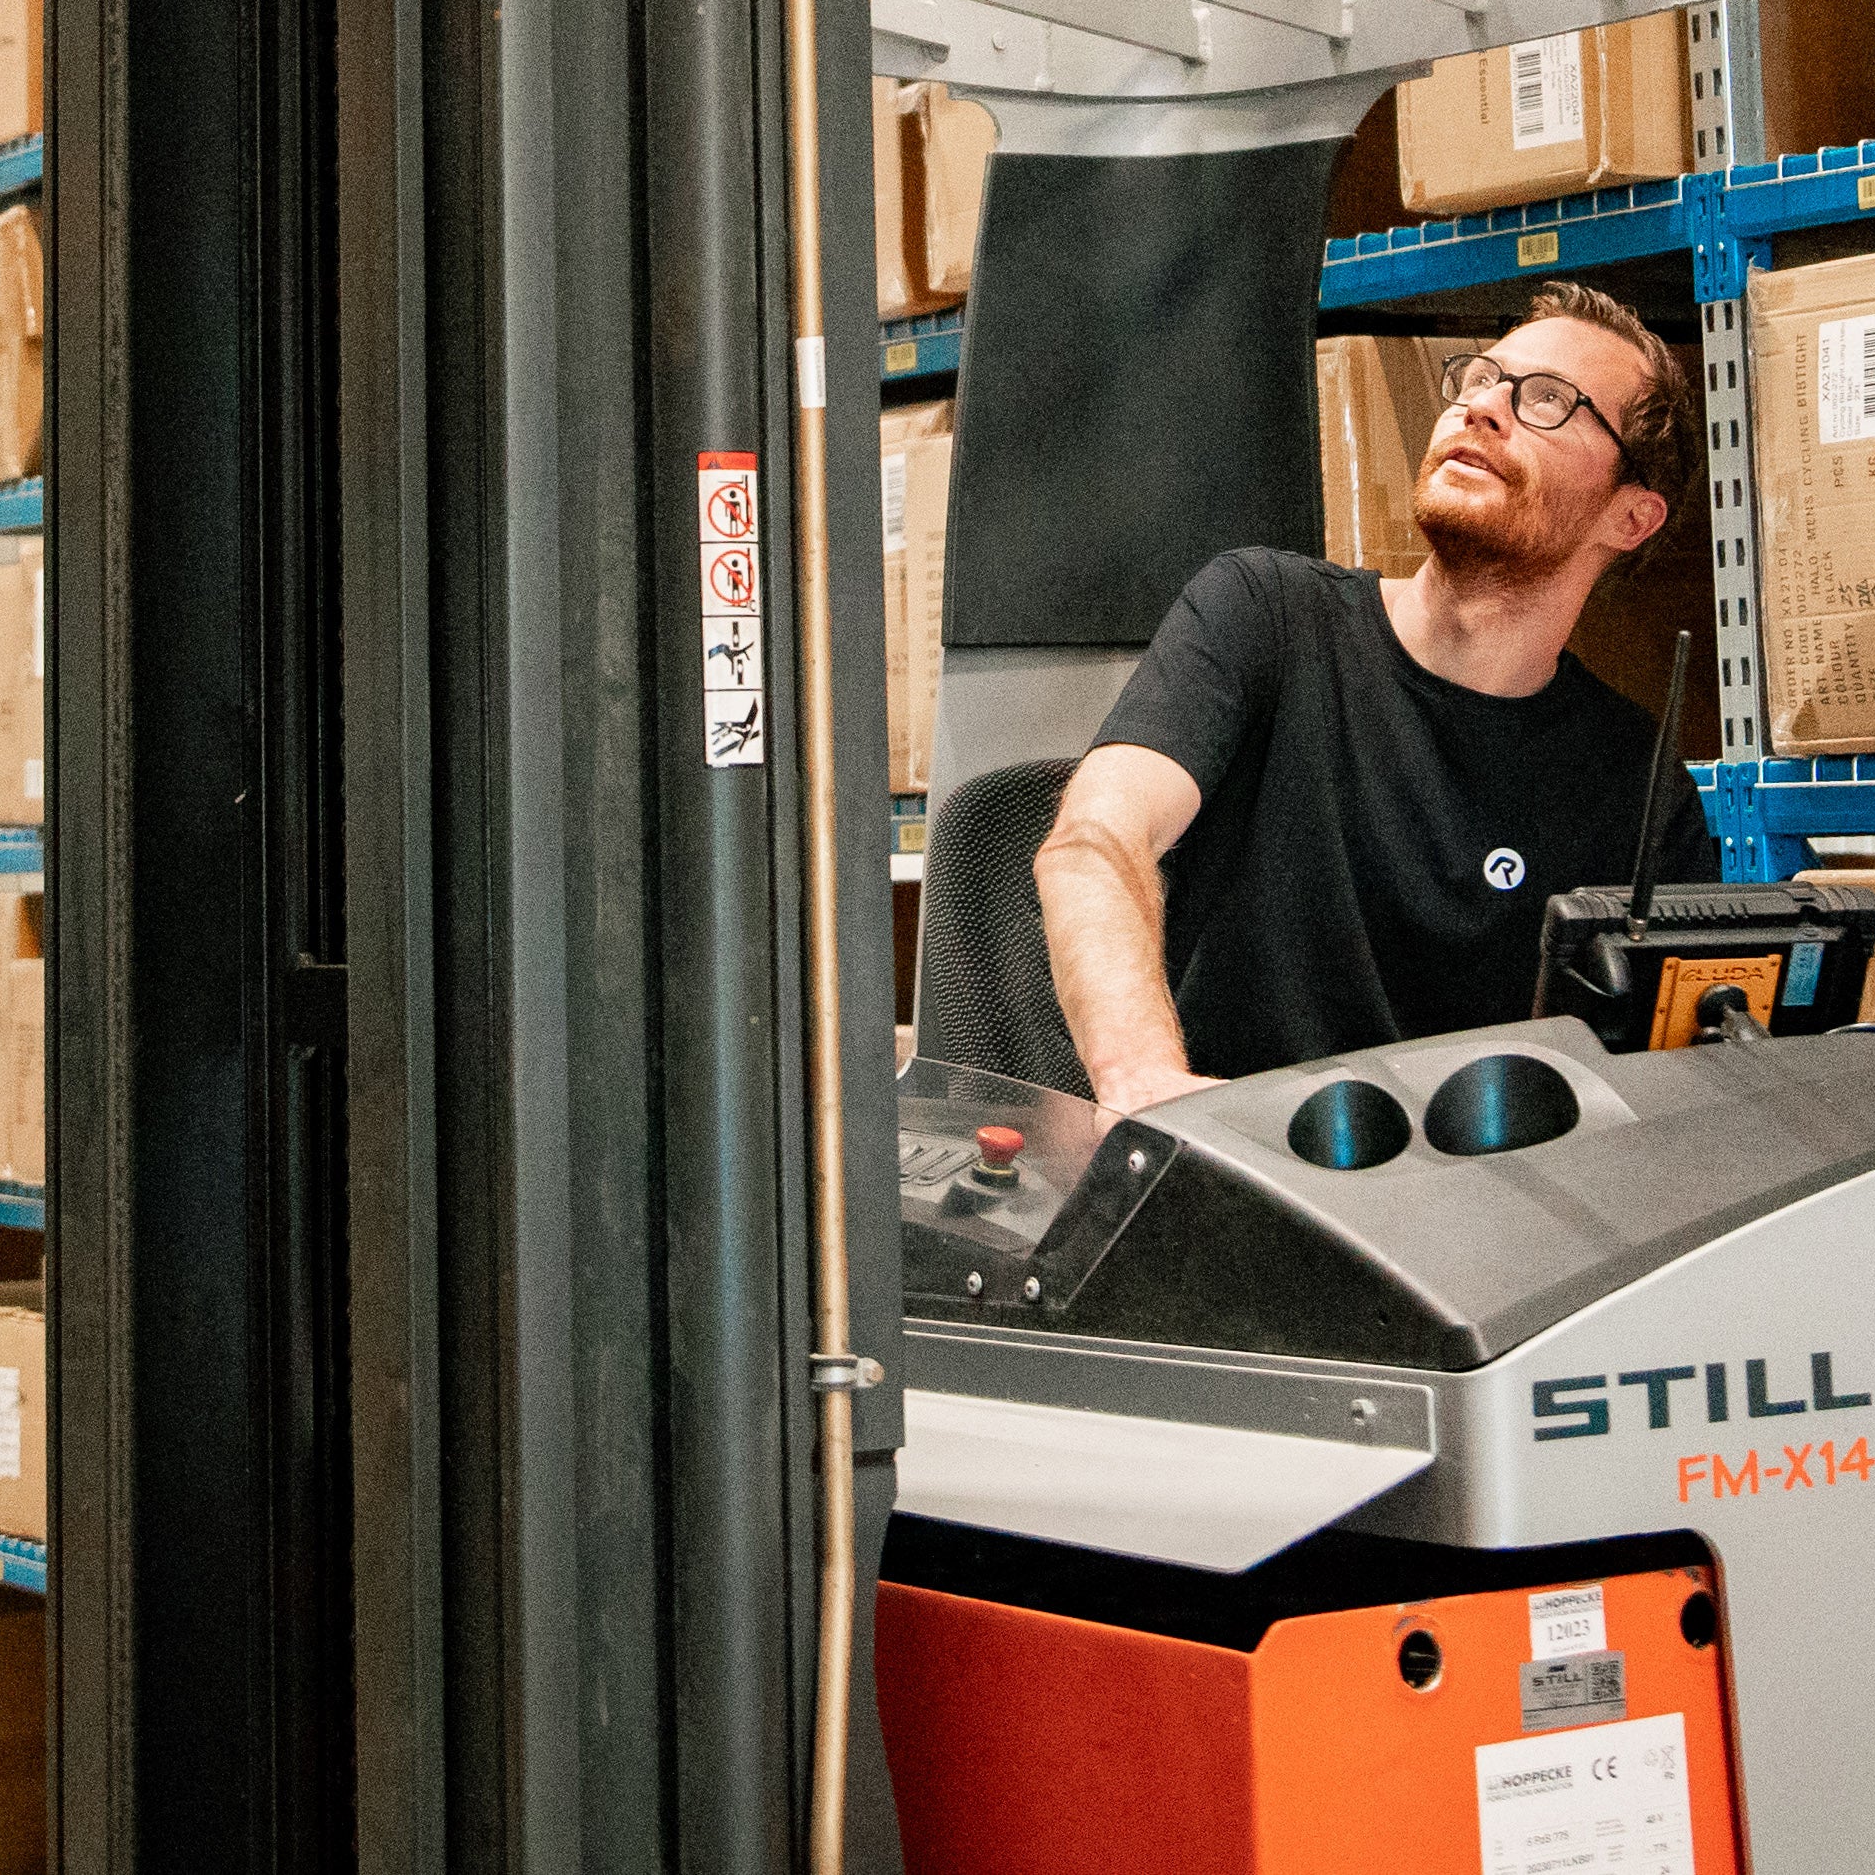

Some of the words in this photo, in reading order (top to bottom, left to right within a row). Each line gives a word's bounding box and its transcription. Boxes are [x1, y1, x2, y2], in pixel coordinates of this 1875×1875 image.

[1795, 333, 1809, 408] BIBTIGHT
[1799, 414, 1813, 487] CYCLING
[1831, 456, 1845, 489] PCS
[1822, 549, 1836, 605] BLACK
[1843, 622, 1867, 704] QUANTITY
[1532, 1351, 1873, 1443] STILL
[1544, 1590, 1602, 1610] HOPPECKE
[1547, 1619, 1591, 1642] 12023
[1532, 1671, 1583, 1688] STILL
[1502, 1765, 1573, 1789] HOPPECKE
